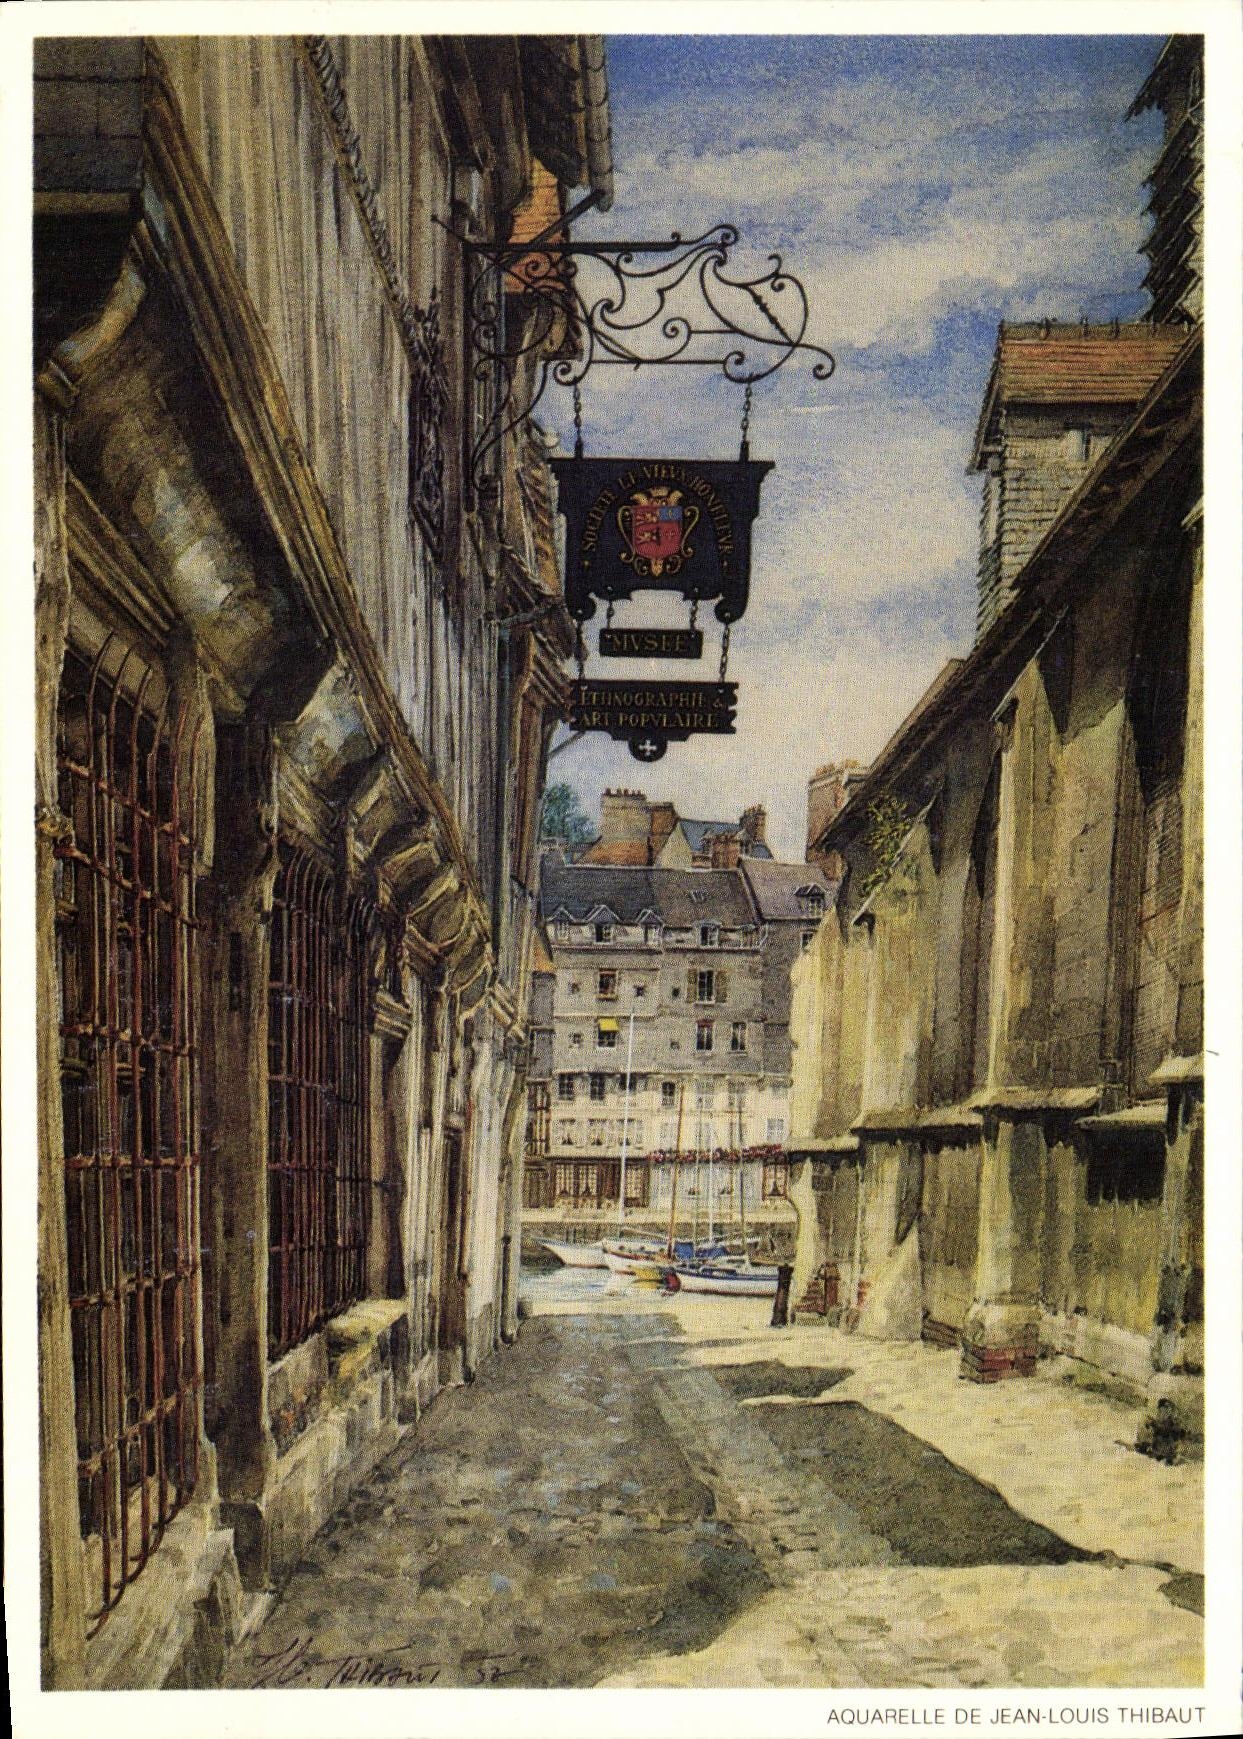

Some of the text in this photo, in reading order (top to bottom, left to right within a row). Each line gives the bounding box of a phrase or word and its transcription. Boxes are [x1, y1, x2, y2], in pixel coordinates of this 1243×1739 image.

[827, 1706, 1206, 1724] AQUARELLE DE JEAN-LOUIS THIBAUT
